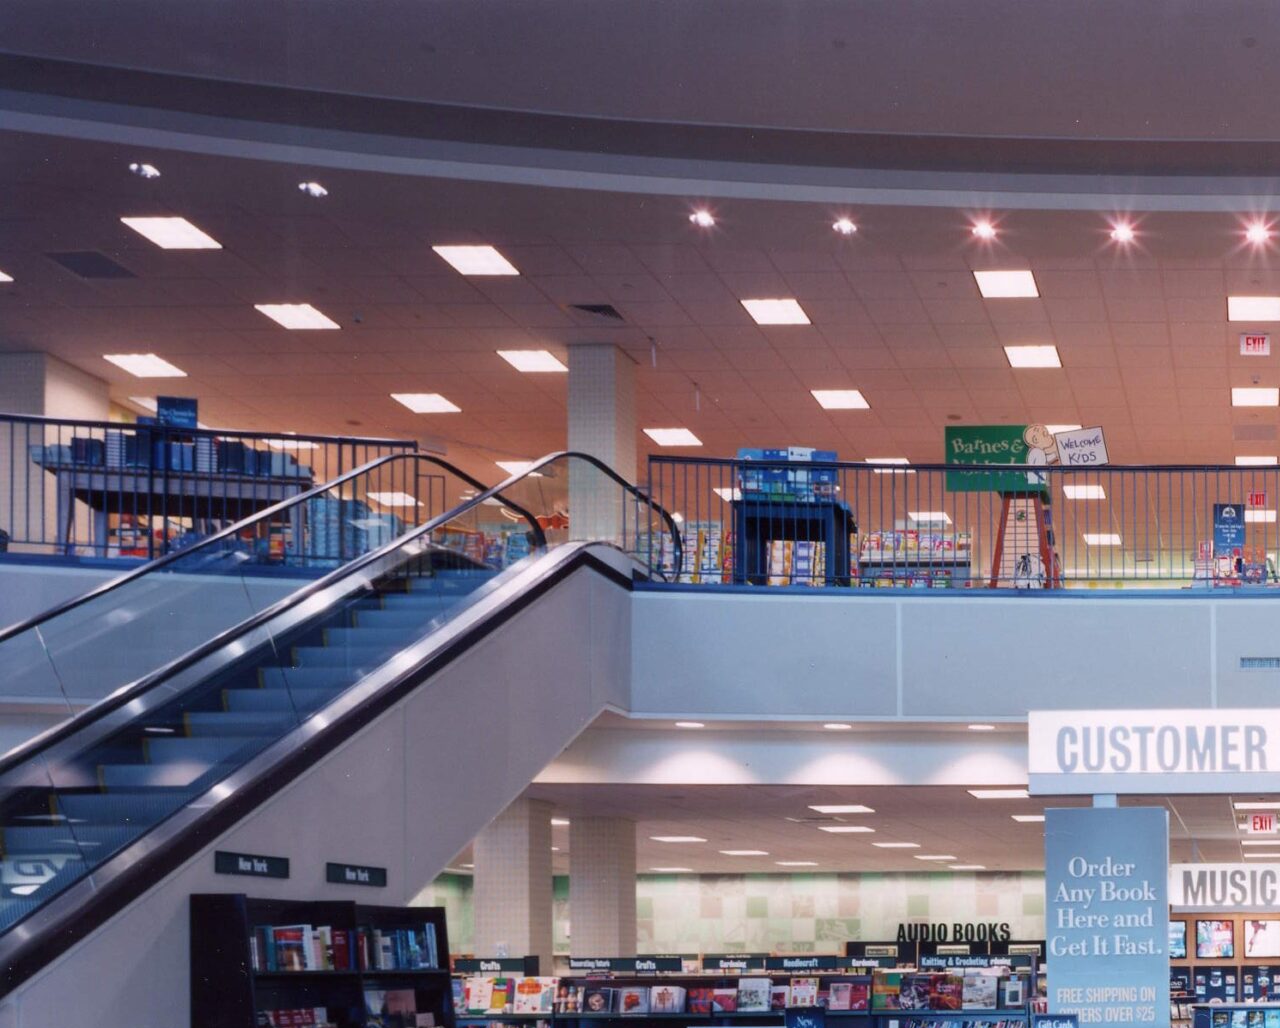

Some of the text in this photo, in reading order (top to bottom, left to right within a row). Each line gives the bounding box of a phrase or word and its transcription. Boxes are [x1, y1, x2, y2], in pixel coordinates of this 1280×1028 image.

[1246, 336, 1266, 351] EXIT
[952, 438, 1024, 455] Barnes &
[1060, 435, 1102, 450] WELCOME
[1068, 451, 1097, 464] KIDS
[1056, 724, 1268, 773] CUSTOMER
[1253, 815, 1272, 831] EXIT
[238, 857, 268, 872] New York
[1068, 856, 1136, 878] Order
[345, 868, 369, 882] New York
[1055, 881, 1157, 909] Any Book
[1183, 870, 1277, 905] MUSIC
[1057, 907, 1154, 929] Here and
[897, 923, 1011, 942] AUDIO BOOKS
[1050, 935, 1162, 957] Get It Fast.
[480, 960, 501, 971] Crafts
[635, 960, 656, 970] Crafts
[783, 958, 818, 968] Needlecraft
[921, 957, 988, 968] Knitting & Crocheting
[1057, 986, 1156, 1003] FREE SHIPPING ON
[797, 1016, 813, 1028] New
[1105, 1006, 1156, 1022] OVER $25
